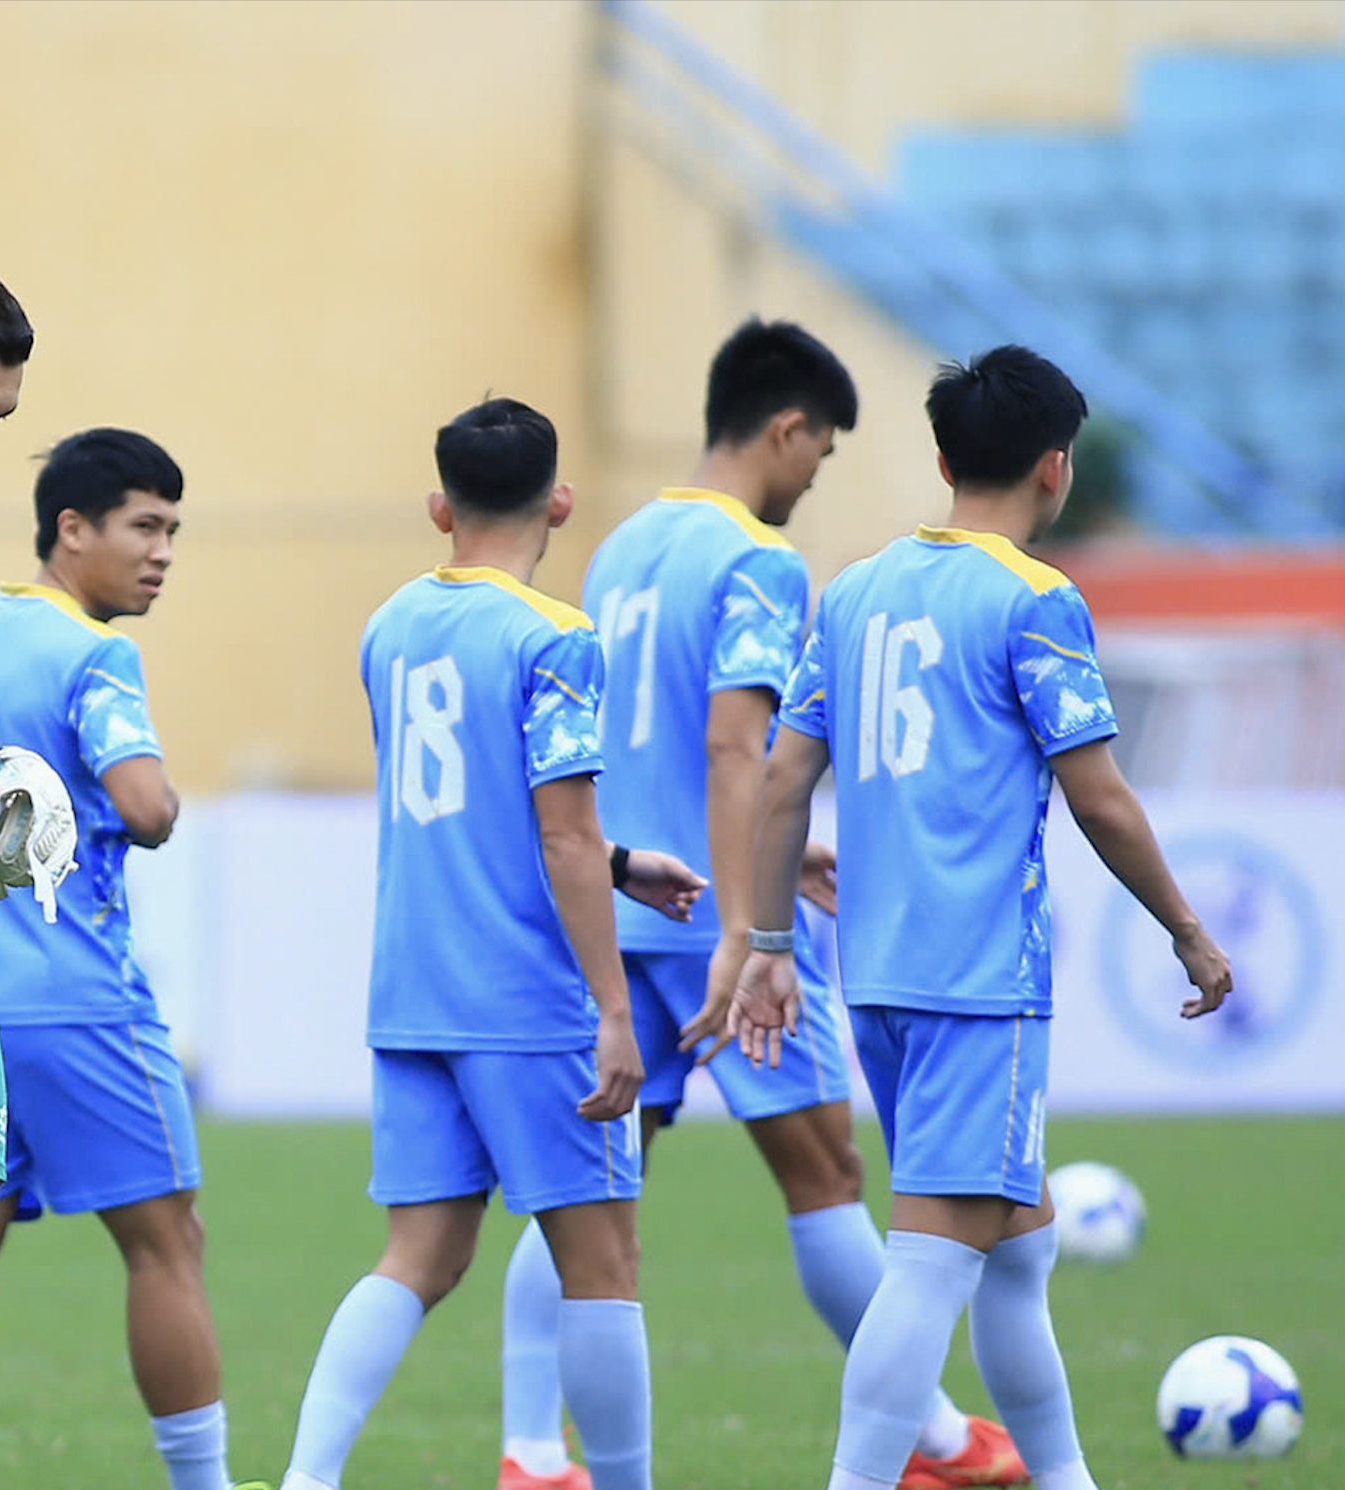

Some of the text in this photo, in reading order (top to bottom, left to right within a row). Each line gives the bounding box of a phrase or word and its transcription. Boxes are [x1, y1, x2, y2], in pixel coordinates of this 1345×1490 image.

[391, 654, 466, 825] 18
[596, 585, 659, 748] 17
[859, 612, 944, 782] 16
